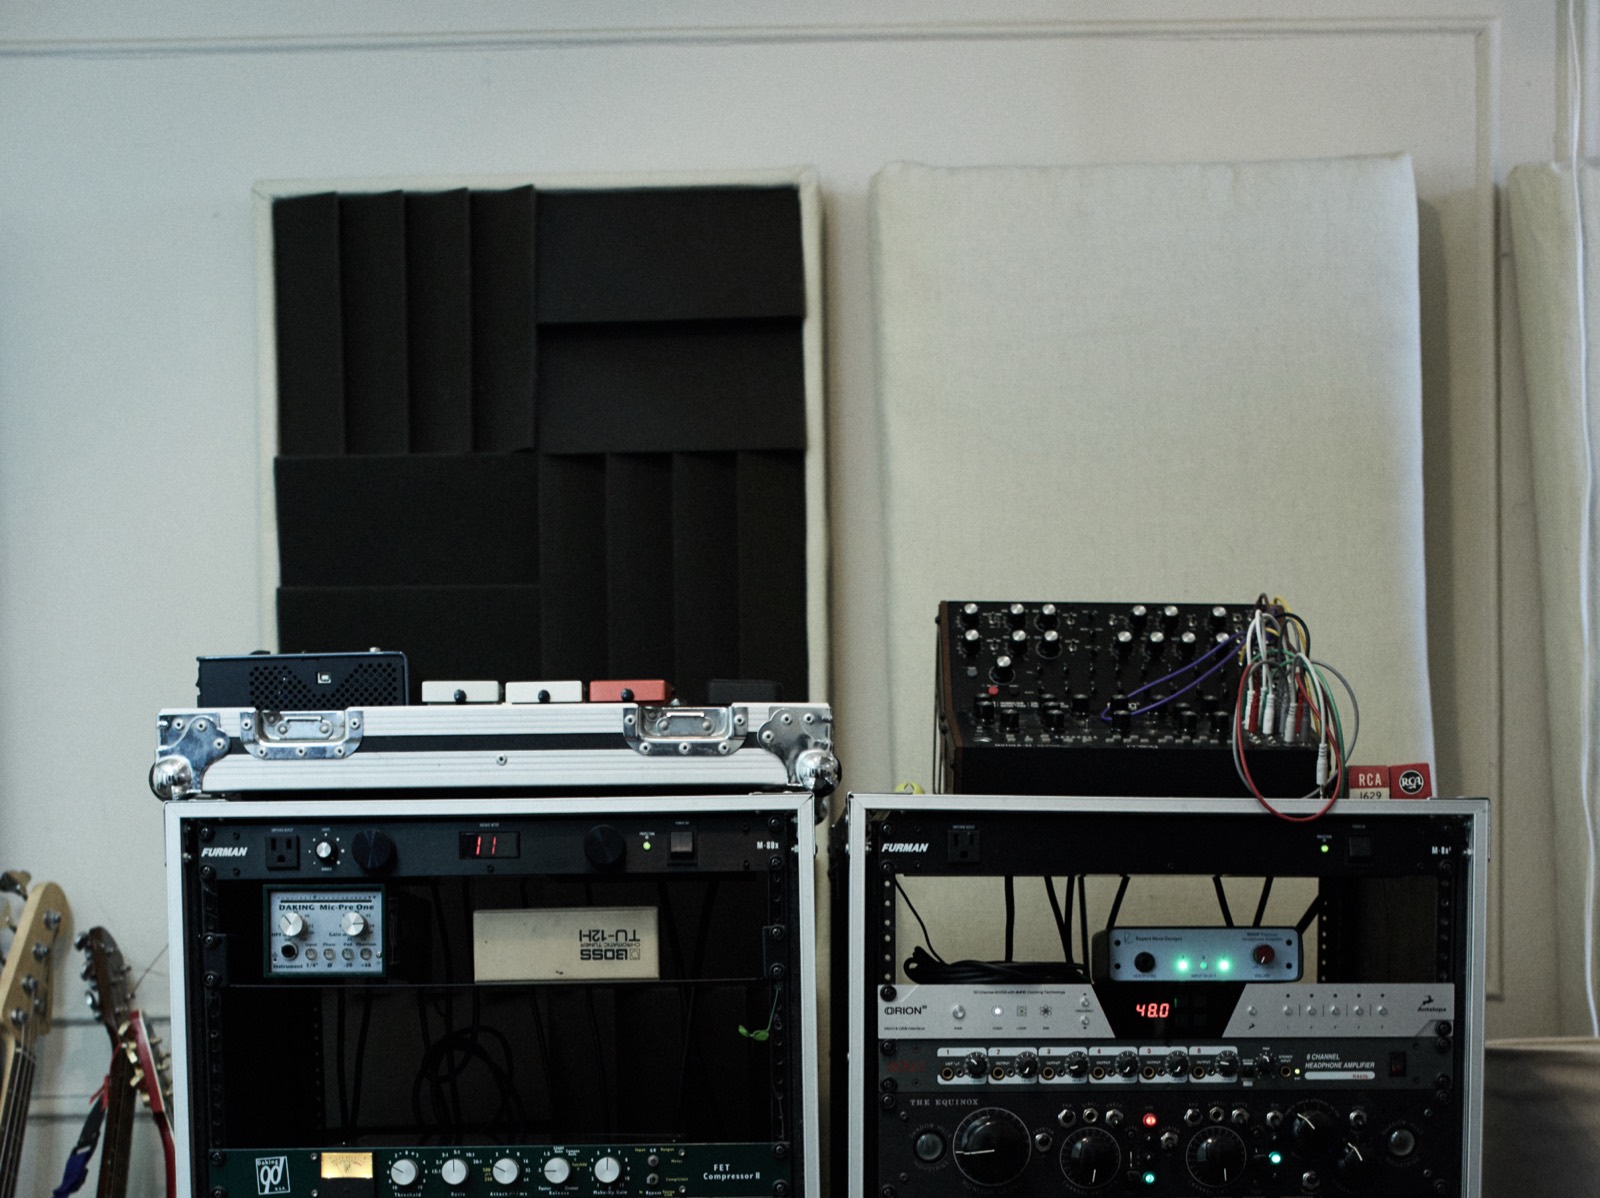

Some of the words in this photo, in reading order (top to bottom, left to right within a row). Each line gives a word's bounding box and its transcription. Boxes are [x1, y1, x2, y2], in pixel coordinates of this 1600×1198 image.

[1358, 773, 1382, 787] RCA
[1400, 776, 1422, 790] RCA
[1359, 791, 1382, 799] 1629
[201, 846, 248, 858] FURMAN
[881, 842, 929, 853] FURMAN
[579, 929, 642, 943] TU-12H
[580, 942, 603, 951] TUNER
[604, 943, 641, 951] CHROMATIC
[580, 949, 629, 961] BOSS
[1311, 1053, 1340, 1061] CHANNEL
[1343, 1061, 1375, 1069] AMPLIFIER
[909, 1098, 931, 1106] THE
[935, 1098, 979, 1106] EQUINOX
[713, 1163, 731, 1172] FET
[703, 1171, 754, 1182] Compressor
